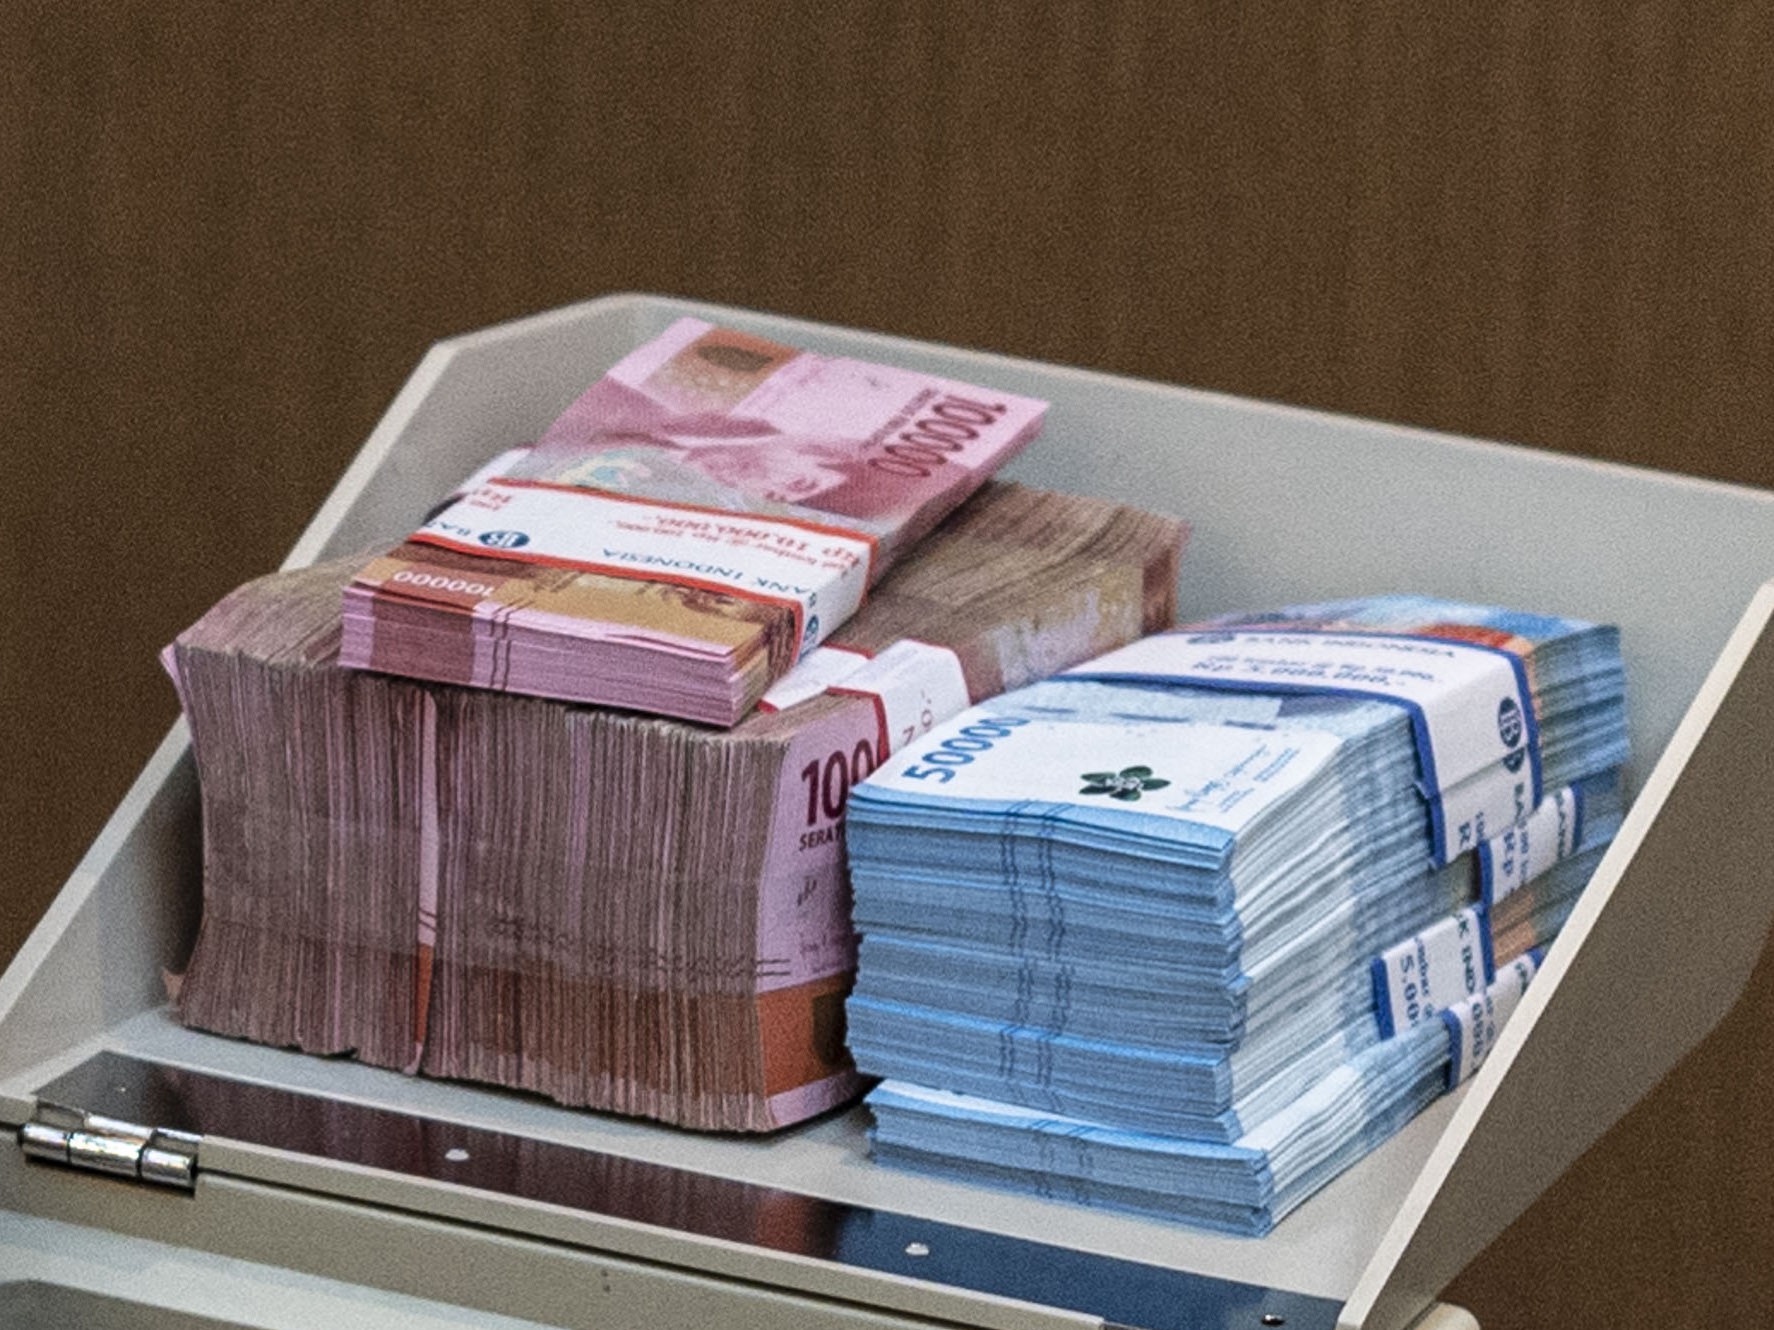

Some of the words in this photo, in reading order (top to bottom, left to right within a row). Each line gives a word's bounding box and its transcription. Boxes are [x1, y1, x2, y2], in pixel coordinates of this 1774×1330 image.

[867, 393, 1007, 478] 100000
[392, 571, 496, 598] 100000
[602, 548, 744, 582] INDONESIA
[902, 716, 1031, 784] 50000
